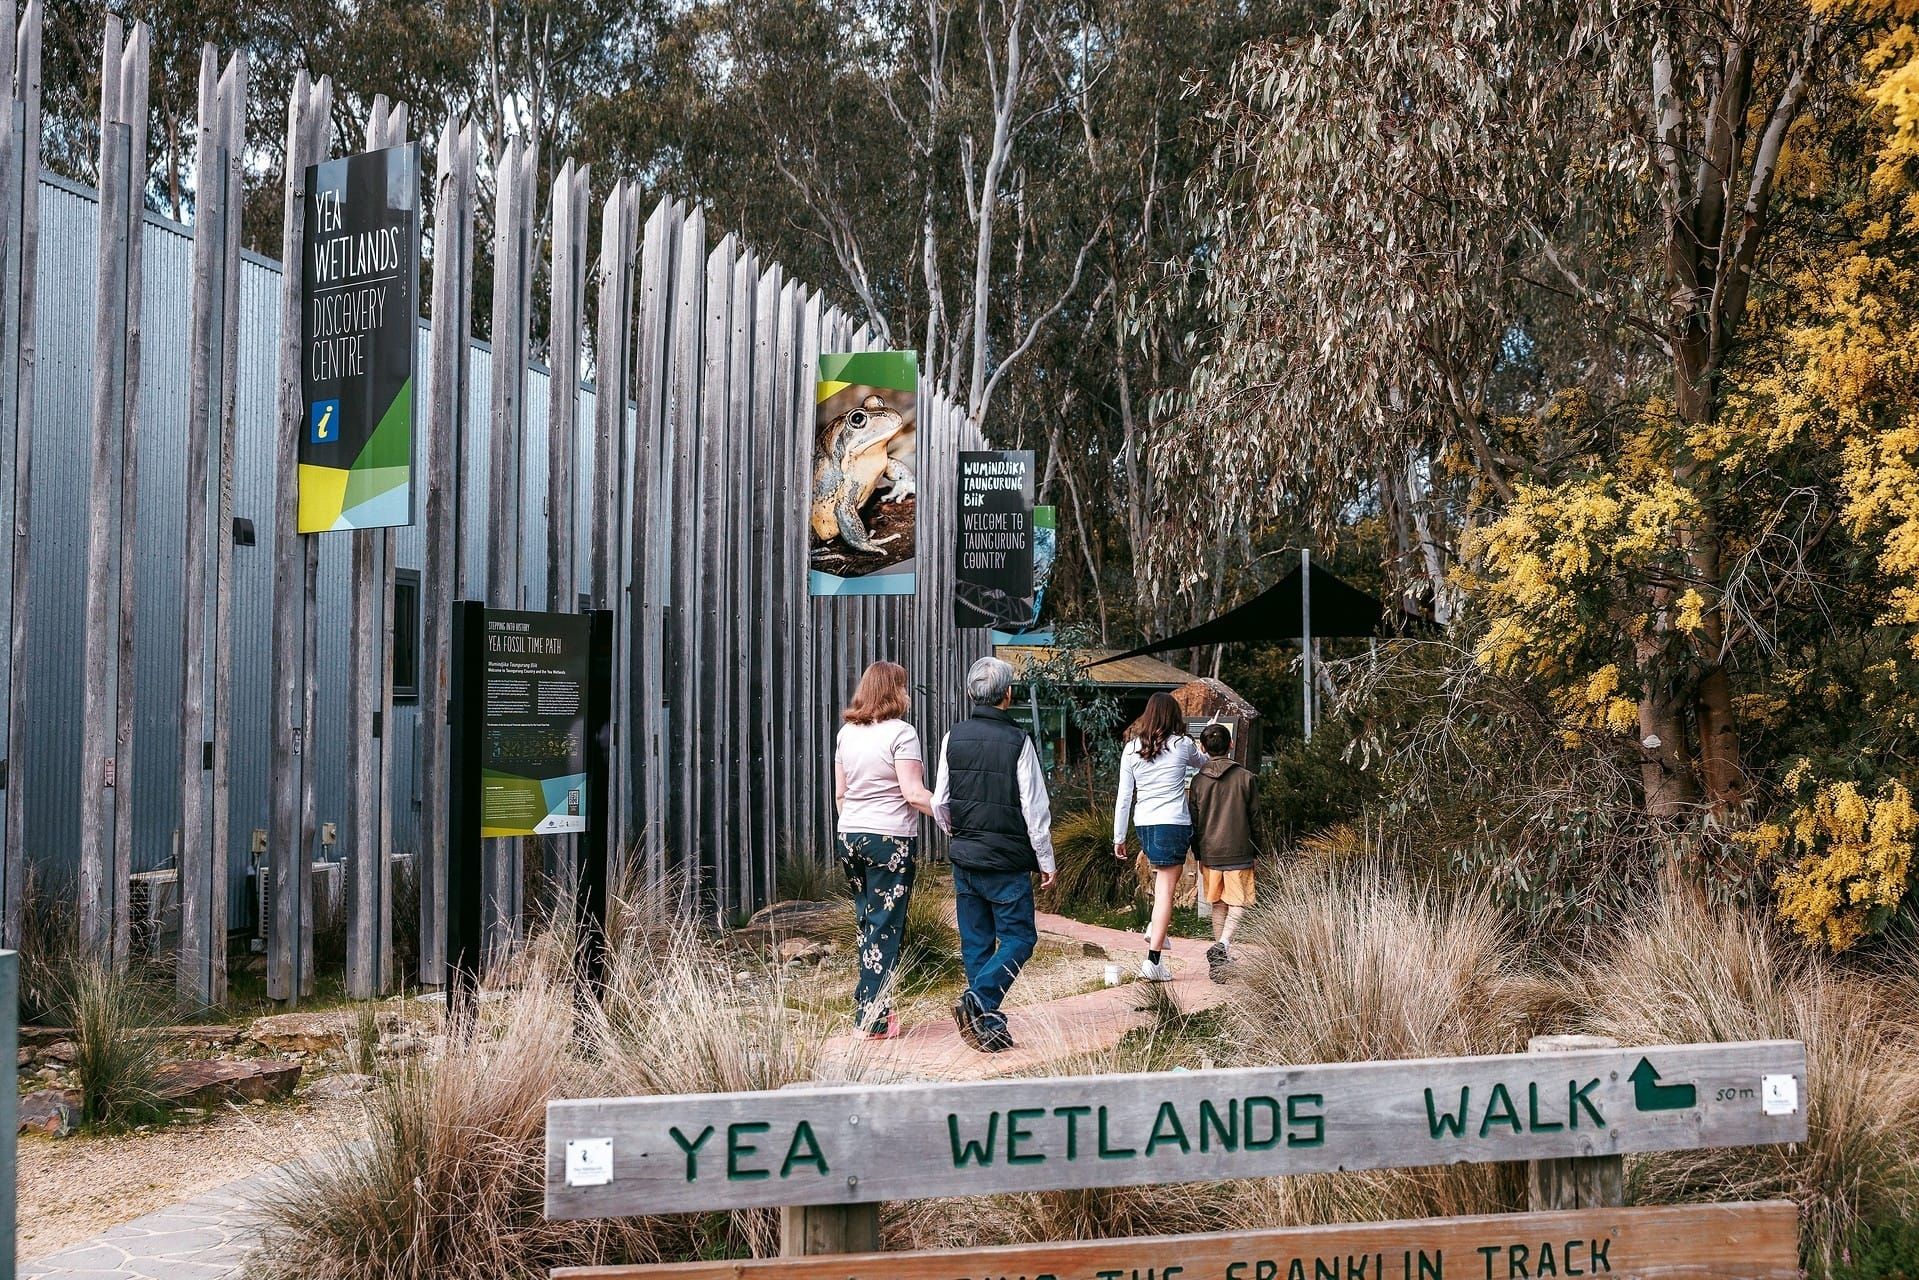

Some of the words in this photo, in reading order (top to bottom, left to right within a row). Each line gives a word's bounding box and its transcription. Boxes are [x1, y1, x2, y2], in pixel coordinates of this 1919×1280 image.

[315, 188, 342, 234] YEA
[314, 226, 399, 284] WETLANDS
[313, 286, 387, 338] DISCOVERY
[312, 334, 365, 382] CENTRE
[964, 477, 1023, 491] TAUNGURUNG
[964, 513, 1008, 531] WELCOME
[1011, 513, 1024, 530] TO
[964, 532, 1026, 550] TAUNGURUNG
[964, 552, 1007, 569] COUNTRY
[488, 621, 505, 631] STEPPING
[506, 622, 515, 631] INTO
[516, 623, 530, 632] HISTORY
[488, 634, 501, 652] YEA
[503, 635, 525, 653] FOSSIL
[527, 637, 543, 654] TIME
[545, 638, 562, 655] PATH
[669, 1120, 830, 1183] YEA
[947, 1093, 1325, 1169] WETLANDS
[1423, 1077, 1606, 1140] WALK
[1477, 1238, 1612, 1280] TRACK
